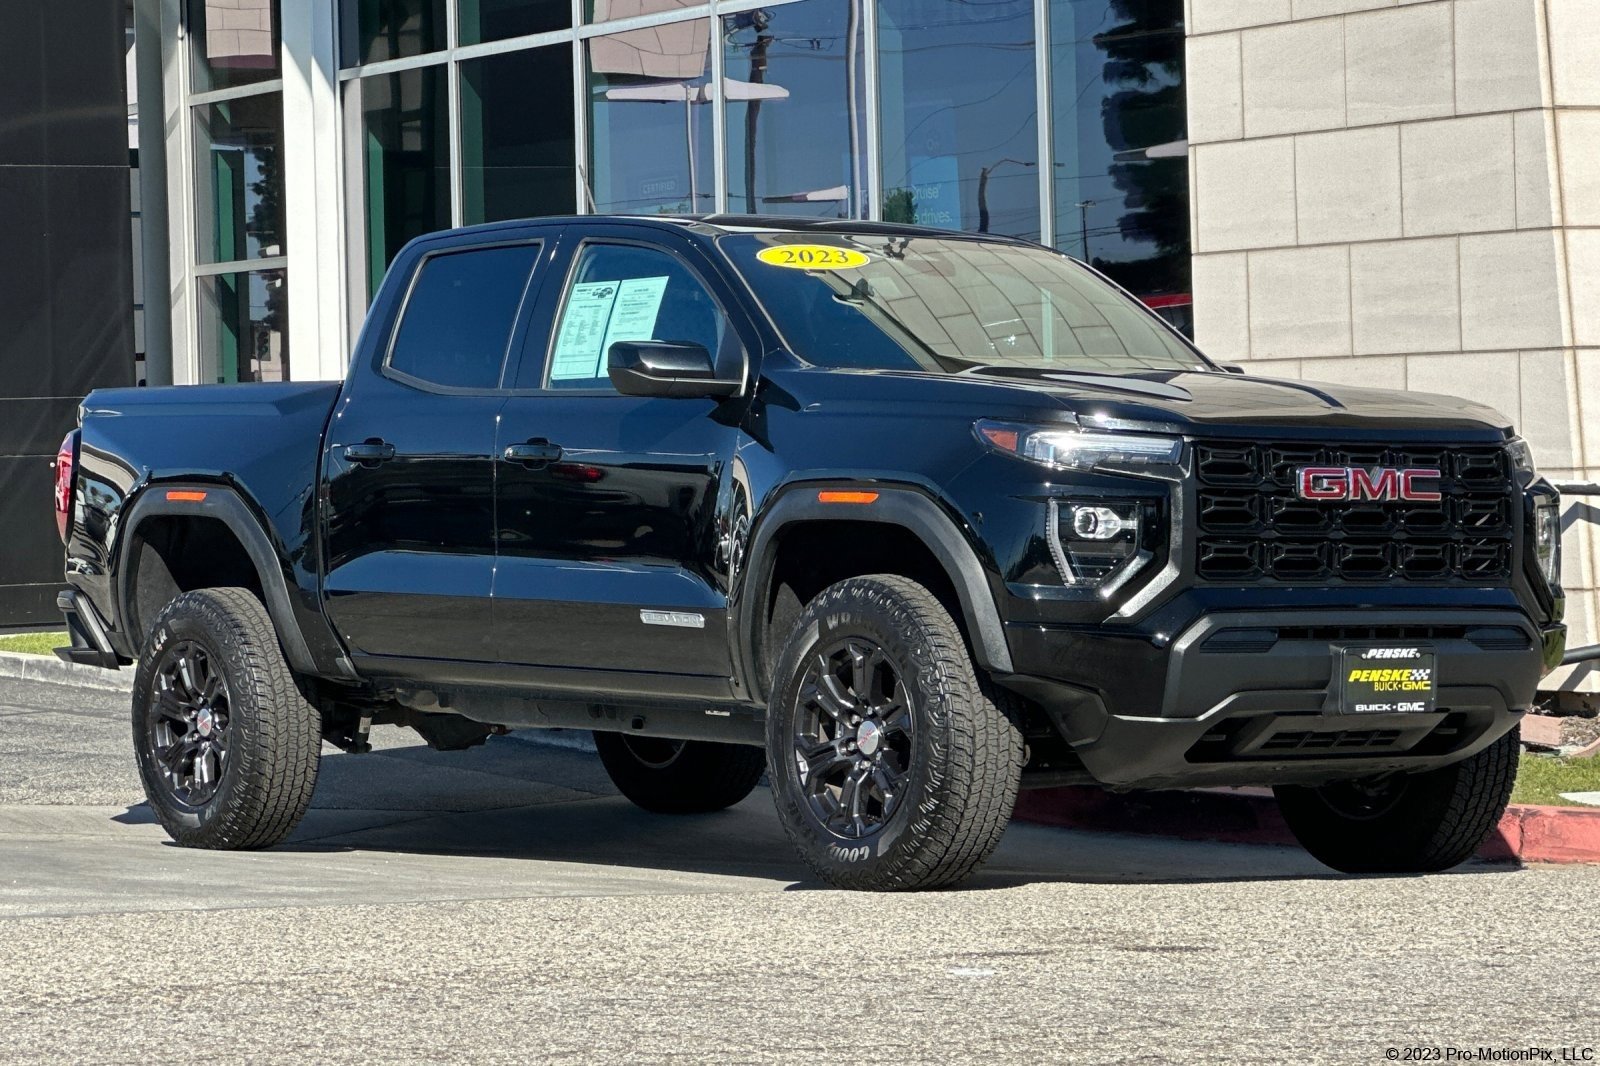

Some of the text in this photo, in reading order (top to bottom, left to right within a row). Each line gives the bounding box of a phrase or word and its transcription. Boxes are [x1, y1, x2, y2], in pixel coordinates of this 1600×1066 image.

[781, 249, 849, 265] 2023
[1298, 466, 1442, 501] GMC
[1366, 648, 1418, 659] PENSKE
[1349, 669, 1413, 682] PENSKE
[1355, 701, 1425, 712] BUICK GMC
